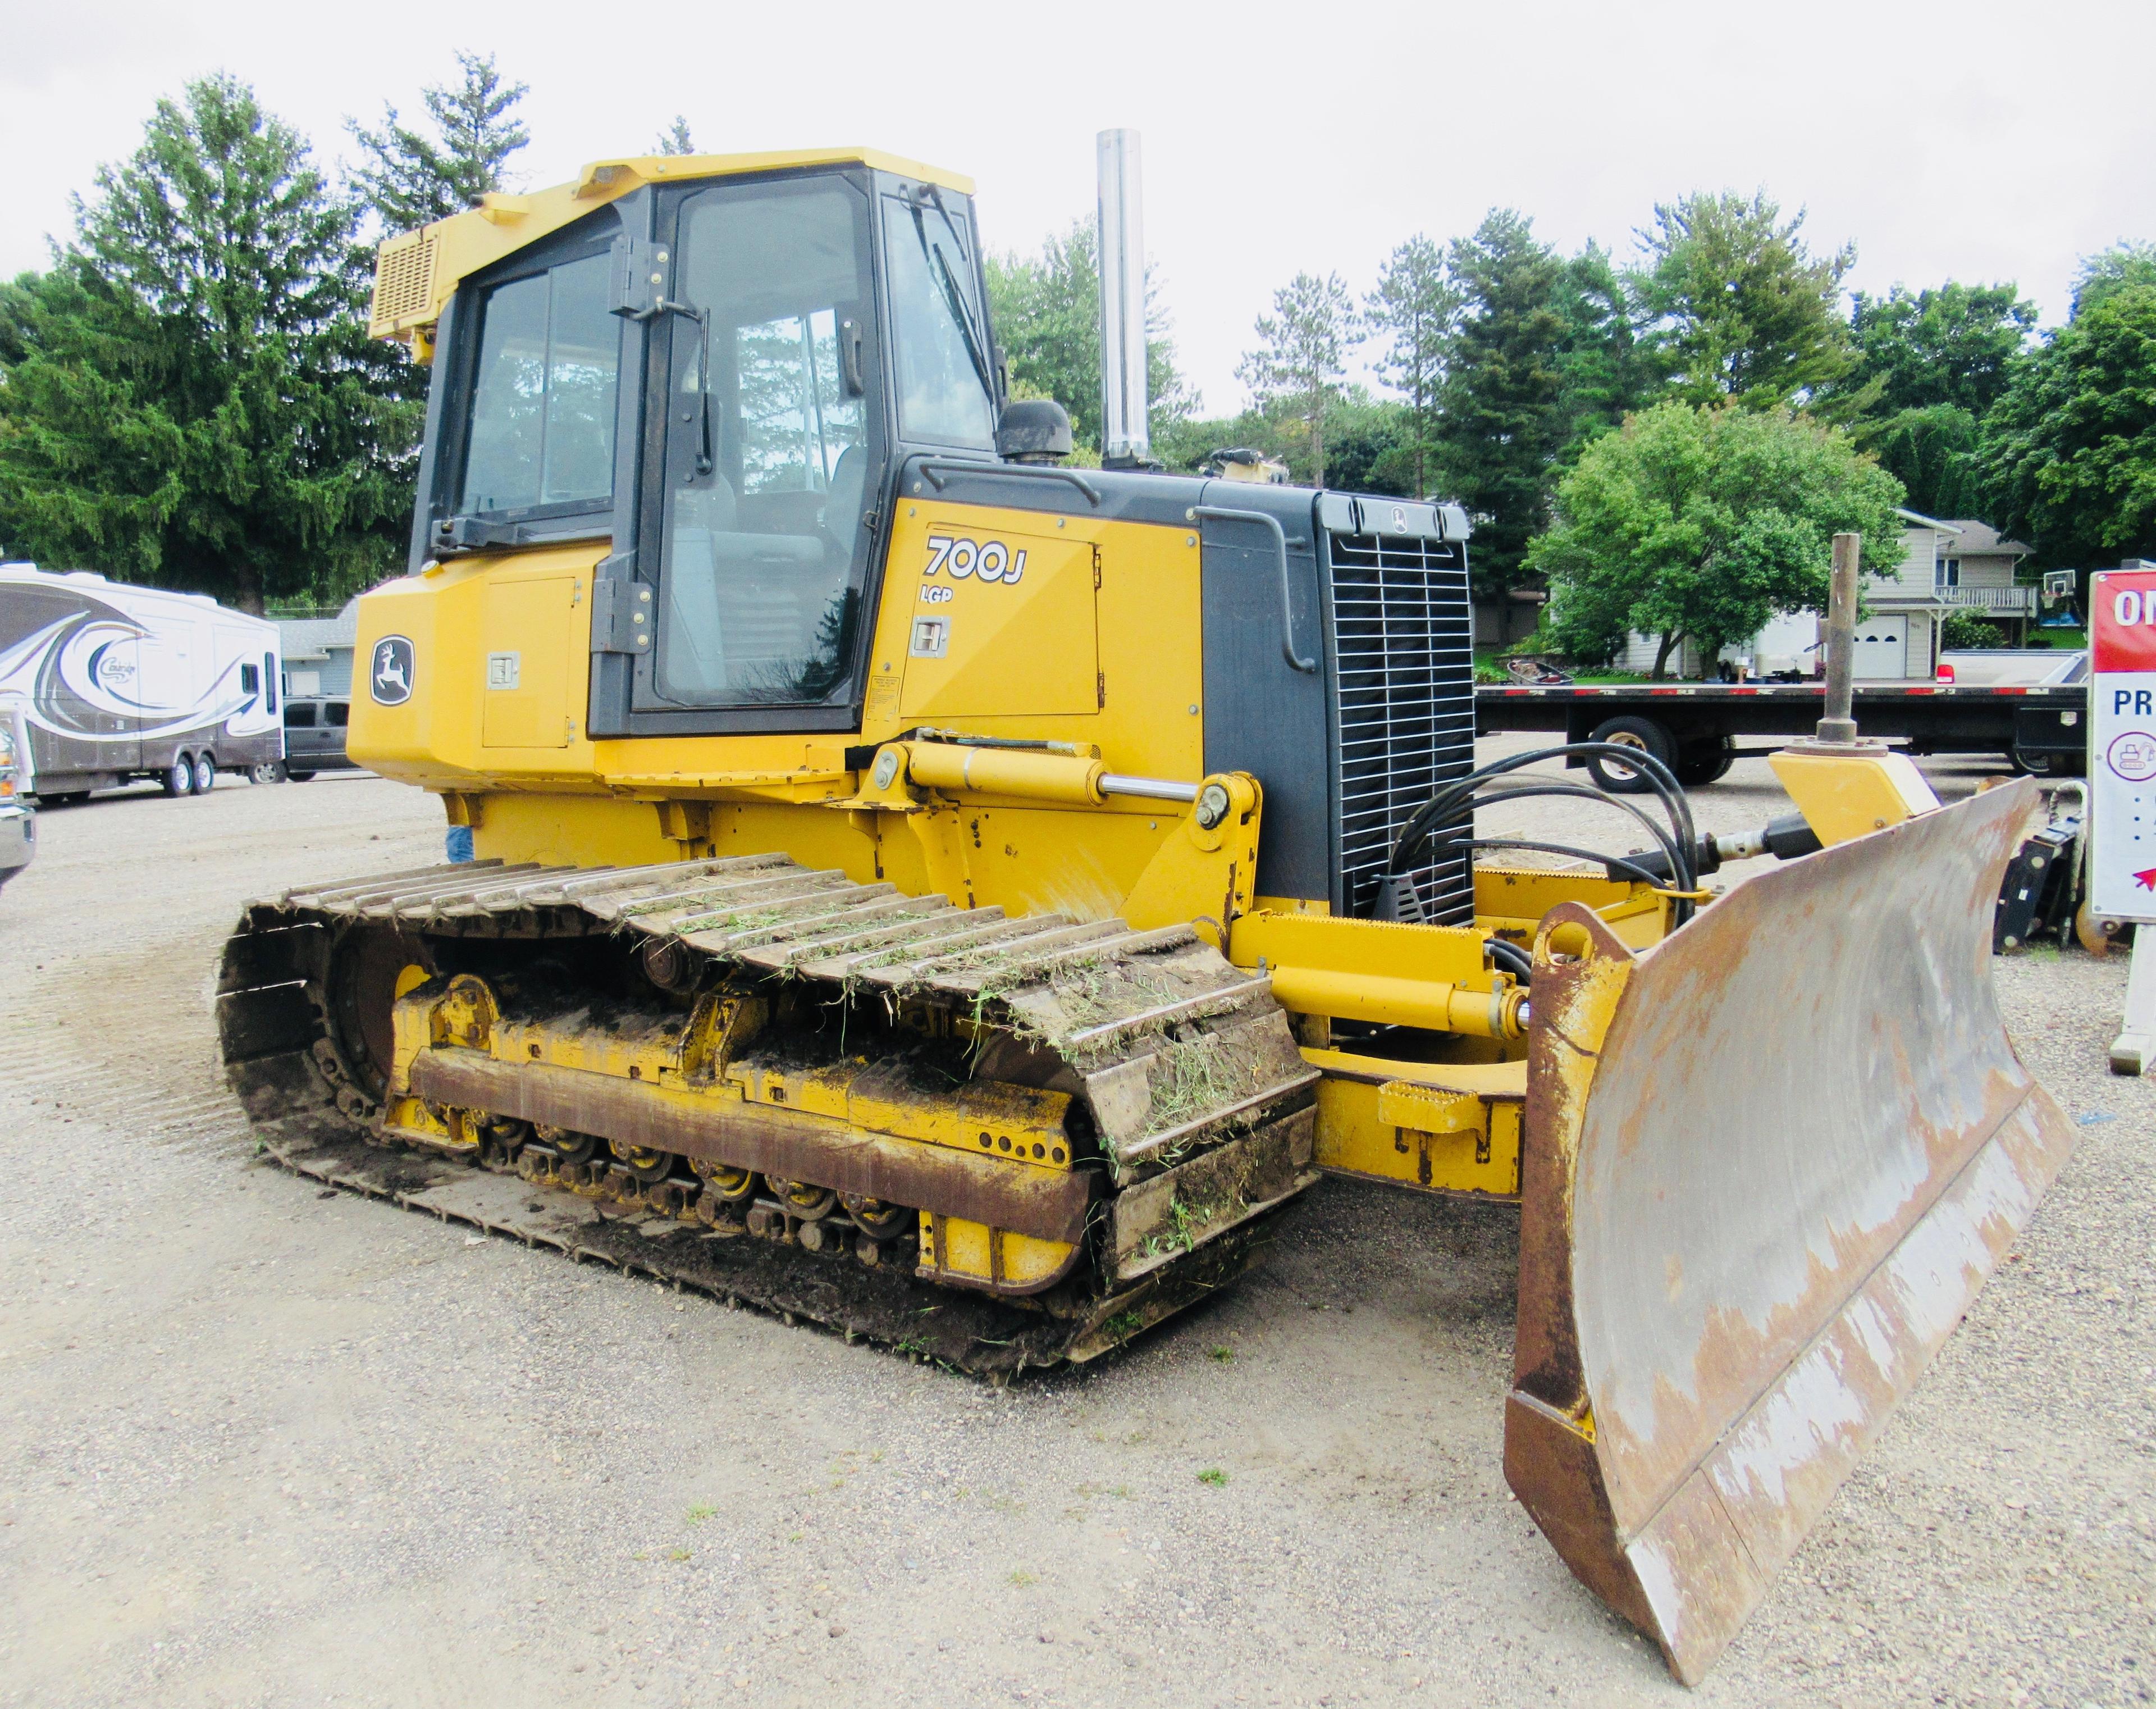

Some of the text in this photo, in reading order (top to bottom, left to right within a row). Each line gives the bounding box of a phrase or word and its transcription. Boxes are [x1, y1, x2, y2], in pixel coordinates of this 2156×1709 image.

[924, 535, 1027, 585] 700J
[920, 584, 953, 604] LGP
[2114, 690, 2152, 715] PR
